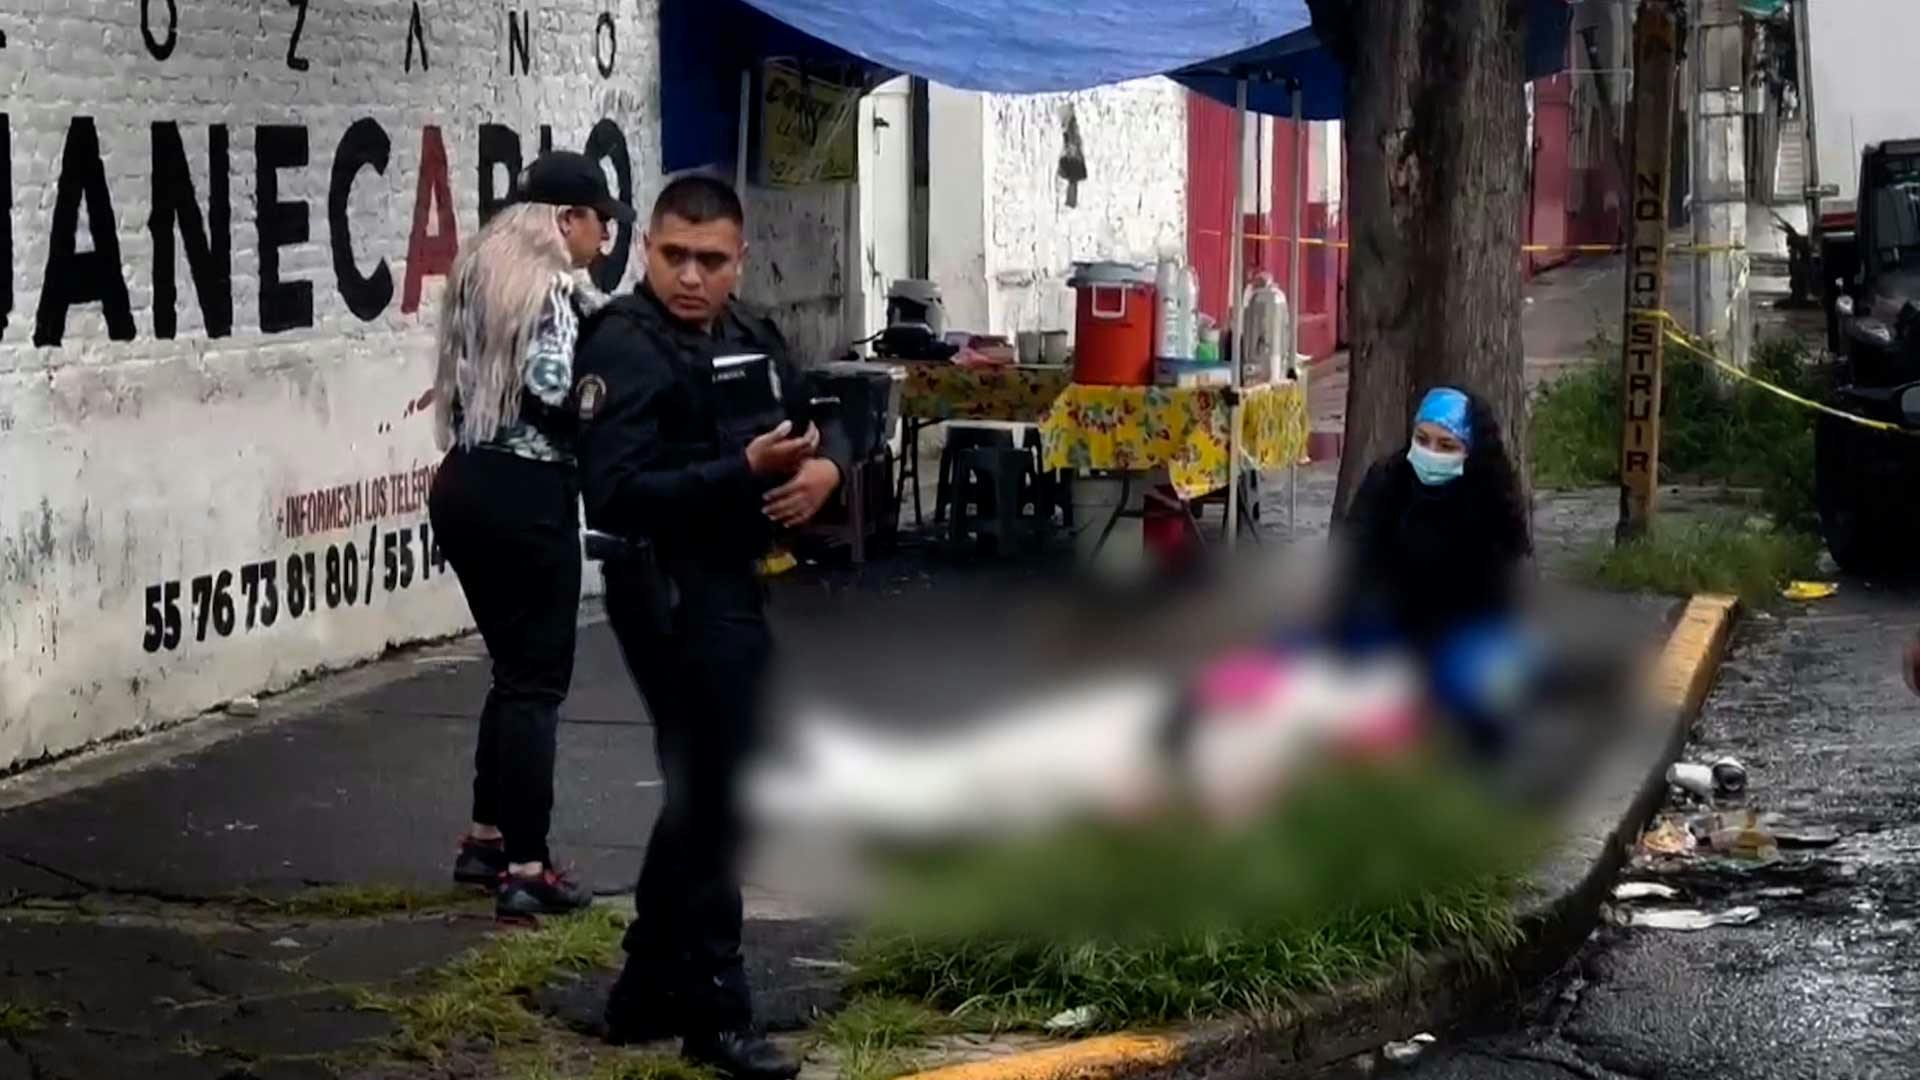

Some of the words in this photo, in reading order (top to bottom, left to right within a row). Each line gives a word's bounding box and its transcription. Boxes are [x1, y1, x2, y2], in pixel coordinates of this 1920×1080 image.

[0, 0, 617, 79] OZANO
[1637, 174, 1662, 219] NO
[285, 483, 352, 539] INFORMES
[353, 480, 362, 525] A
[364, 474, 388, 522] LOS
[142, 580, 182, 653] 55
[191, 569, 236, 642] 76
[240, 559, 279, 630] 73
[286, 552, 316, 618] 81
[325, 541, 359, 609] 80
[383, 527, 414, 592] 55
